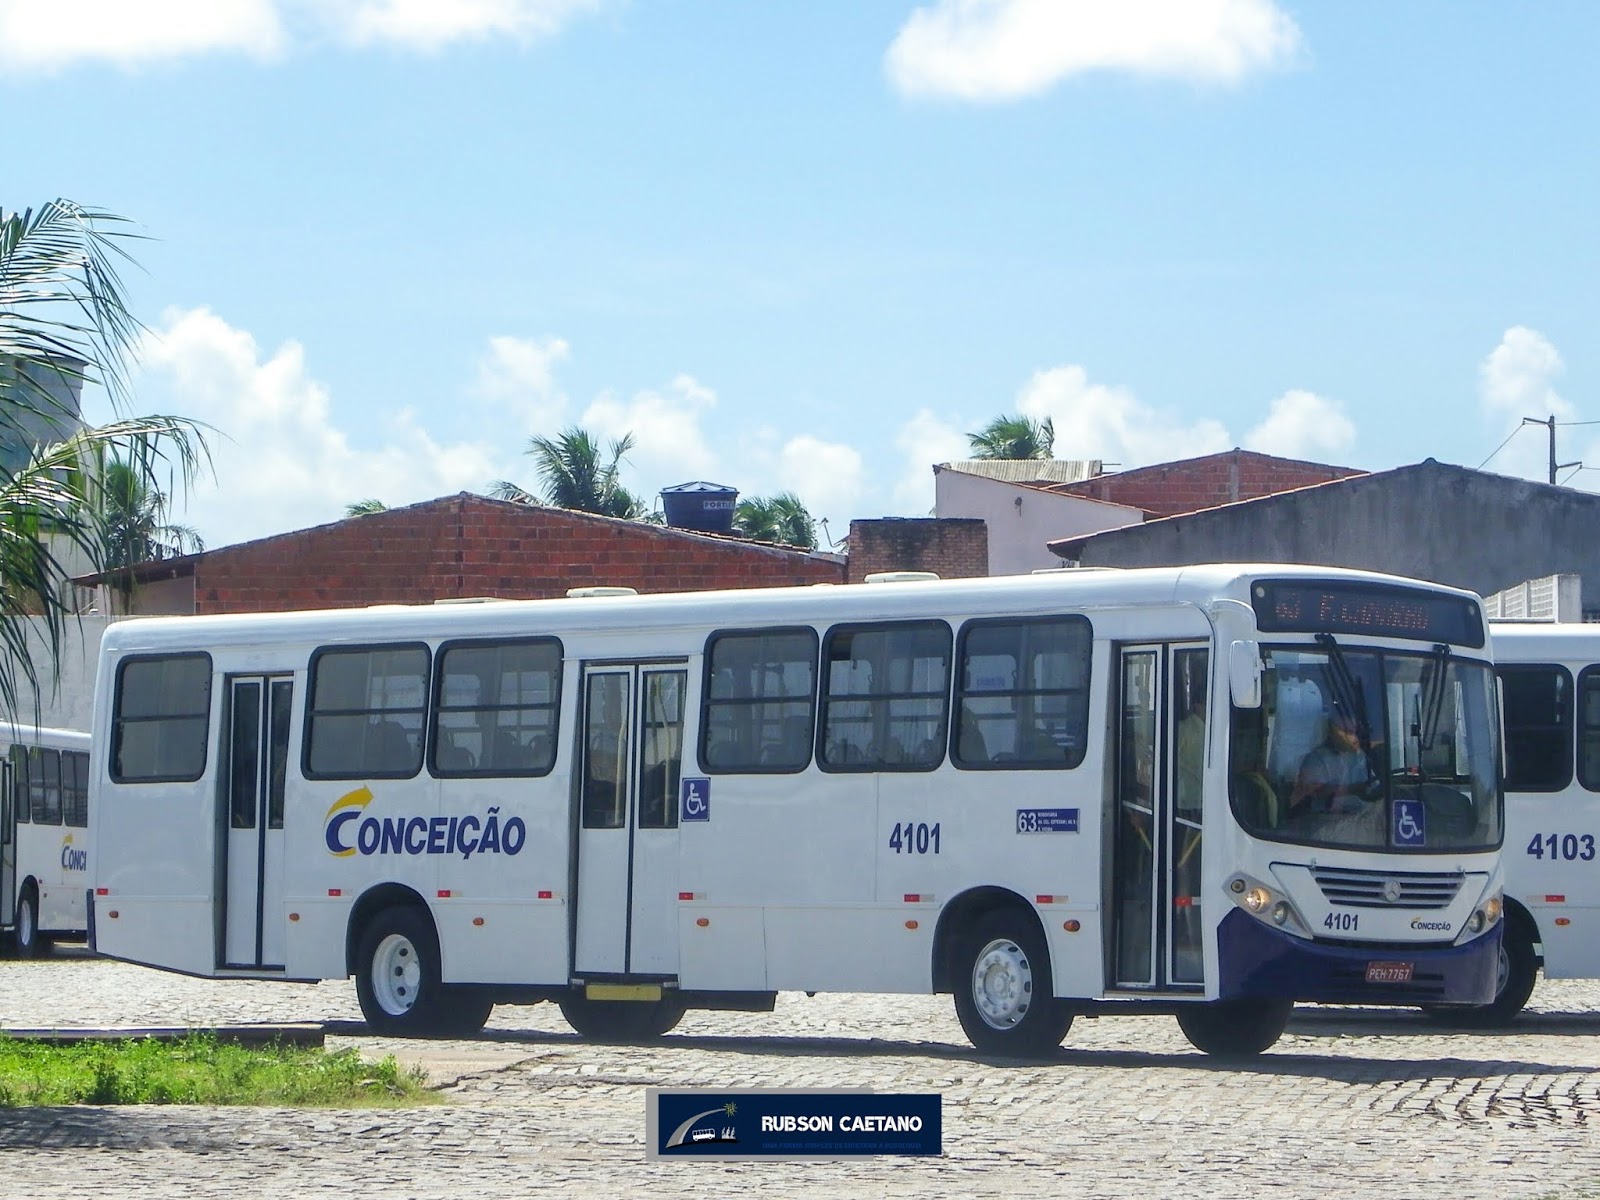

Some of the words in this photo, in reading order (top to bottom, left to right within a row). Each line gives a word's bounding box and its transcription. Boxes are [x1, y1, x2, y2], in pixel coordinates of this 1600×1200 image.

[325, 806, 526, 860] CONCEIÇÃO
[1018, 812, 1037, 832] 63
[889, 822, 940, 854] 4101
[1526, 833, 1596, 860] 4103
[1324, 912, 1359, 931] 4101
